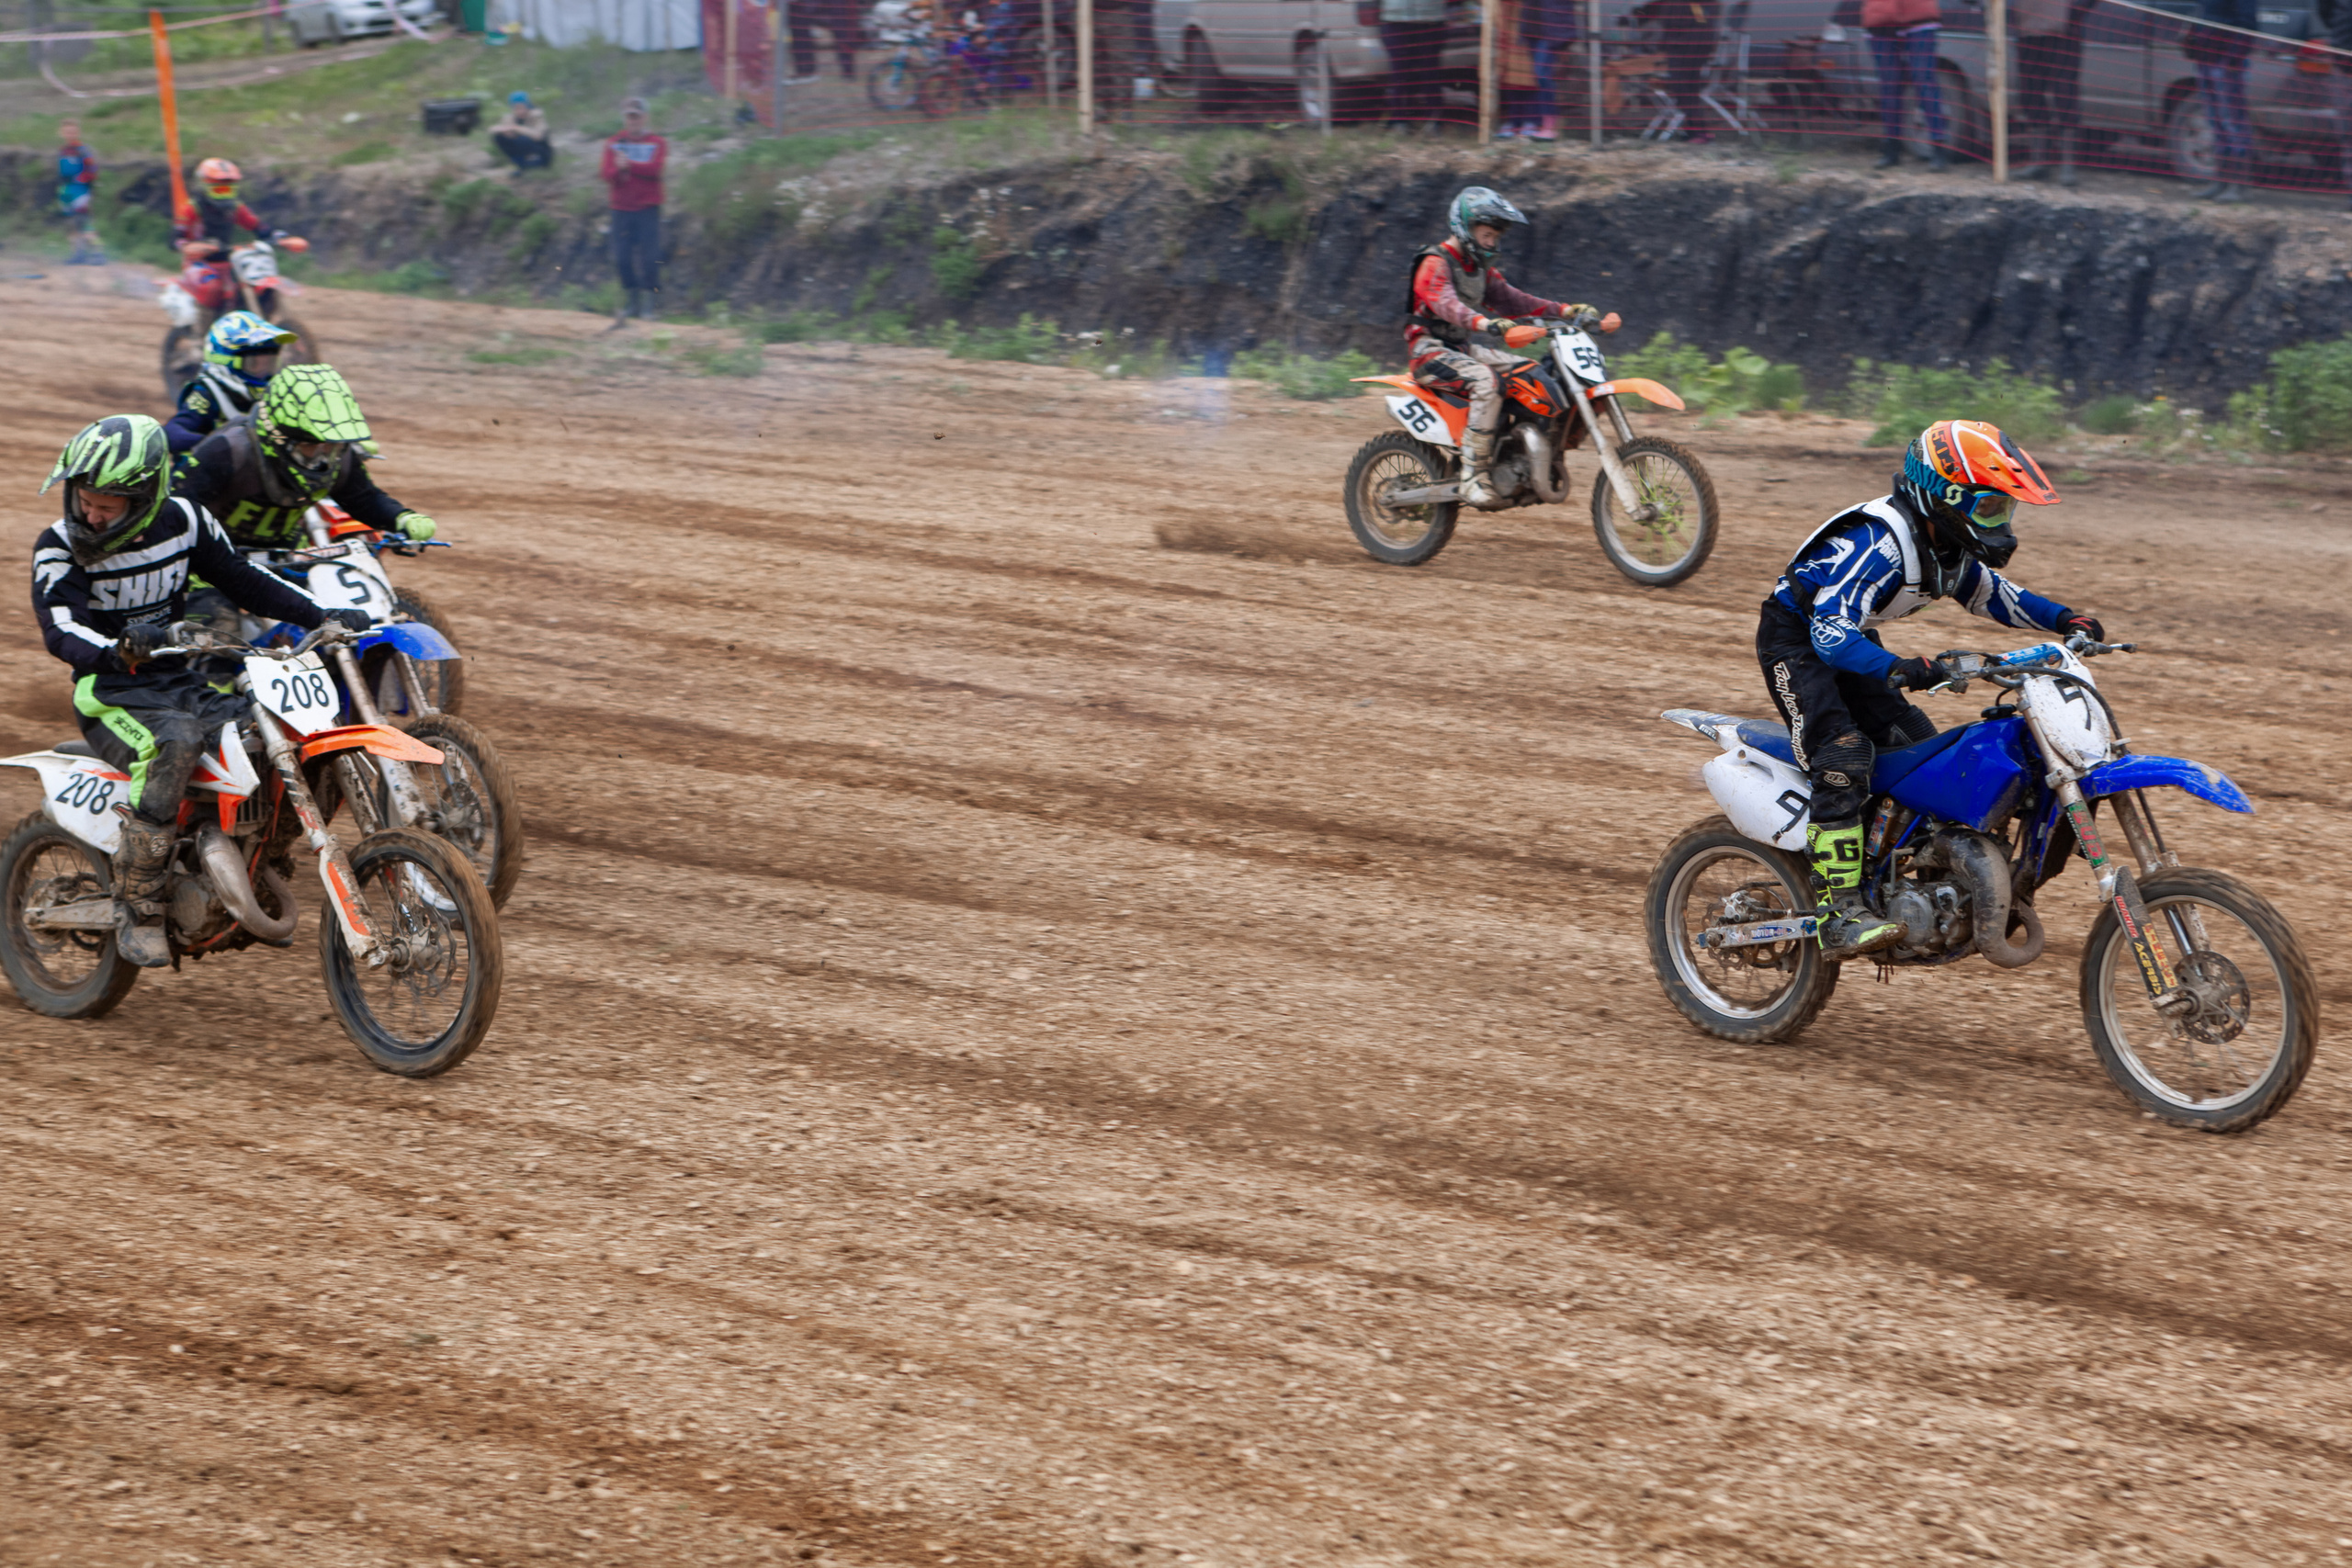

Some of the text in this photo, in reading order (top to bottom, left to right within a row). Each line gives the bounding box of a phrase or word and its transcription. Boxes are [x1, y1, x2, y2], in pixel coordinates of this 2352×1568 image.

[1397, 400, 1436, 433] 56
[336, 567, 371, 605] 5
[271, 673, 330, 714] 208
[55, 773, 115, 815] 208
[1772, 789, 1810, 841] 9
